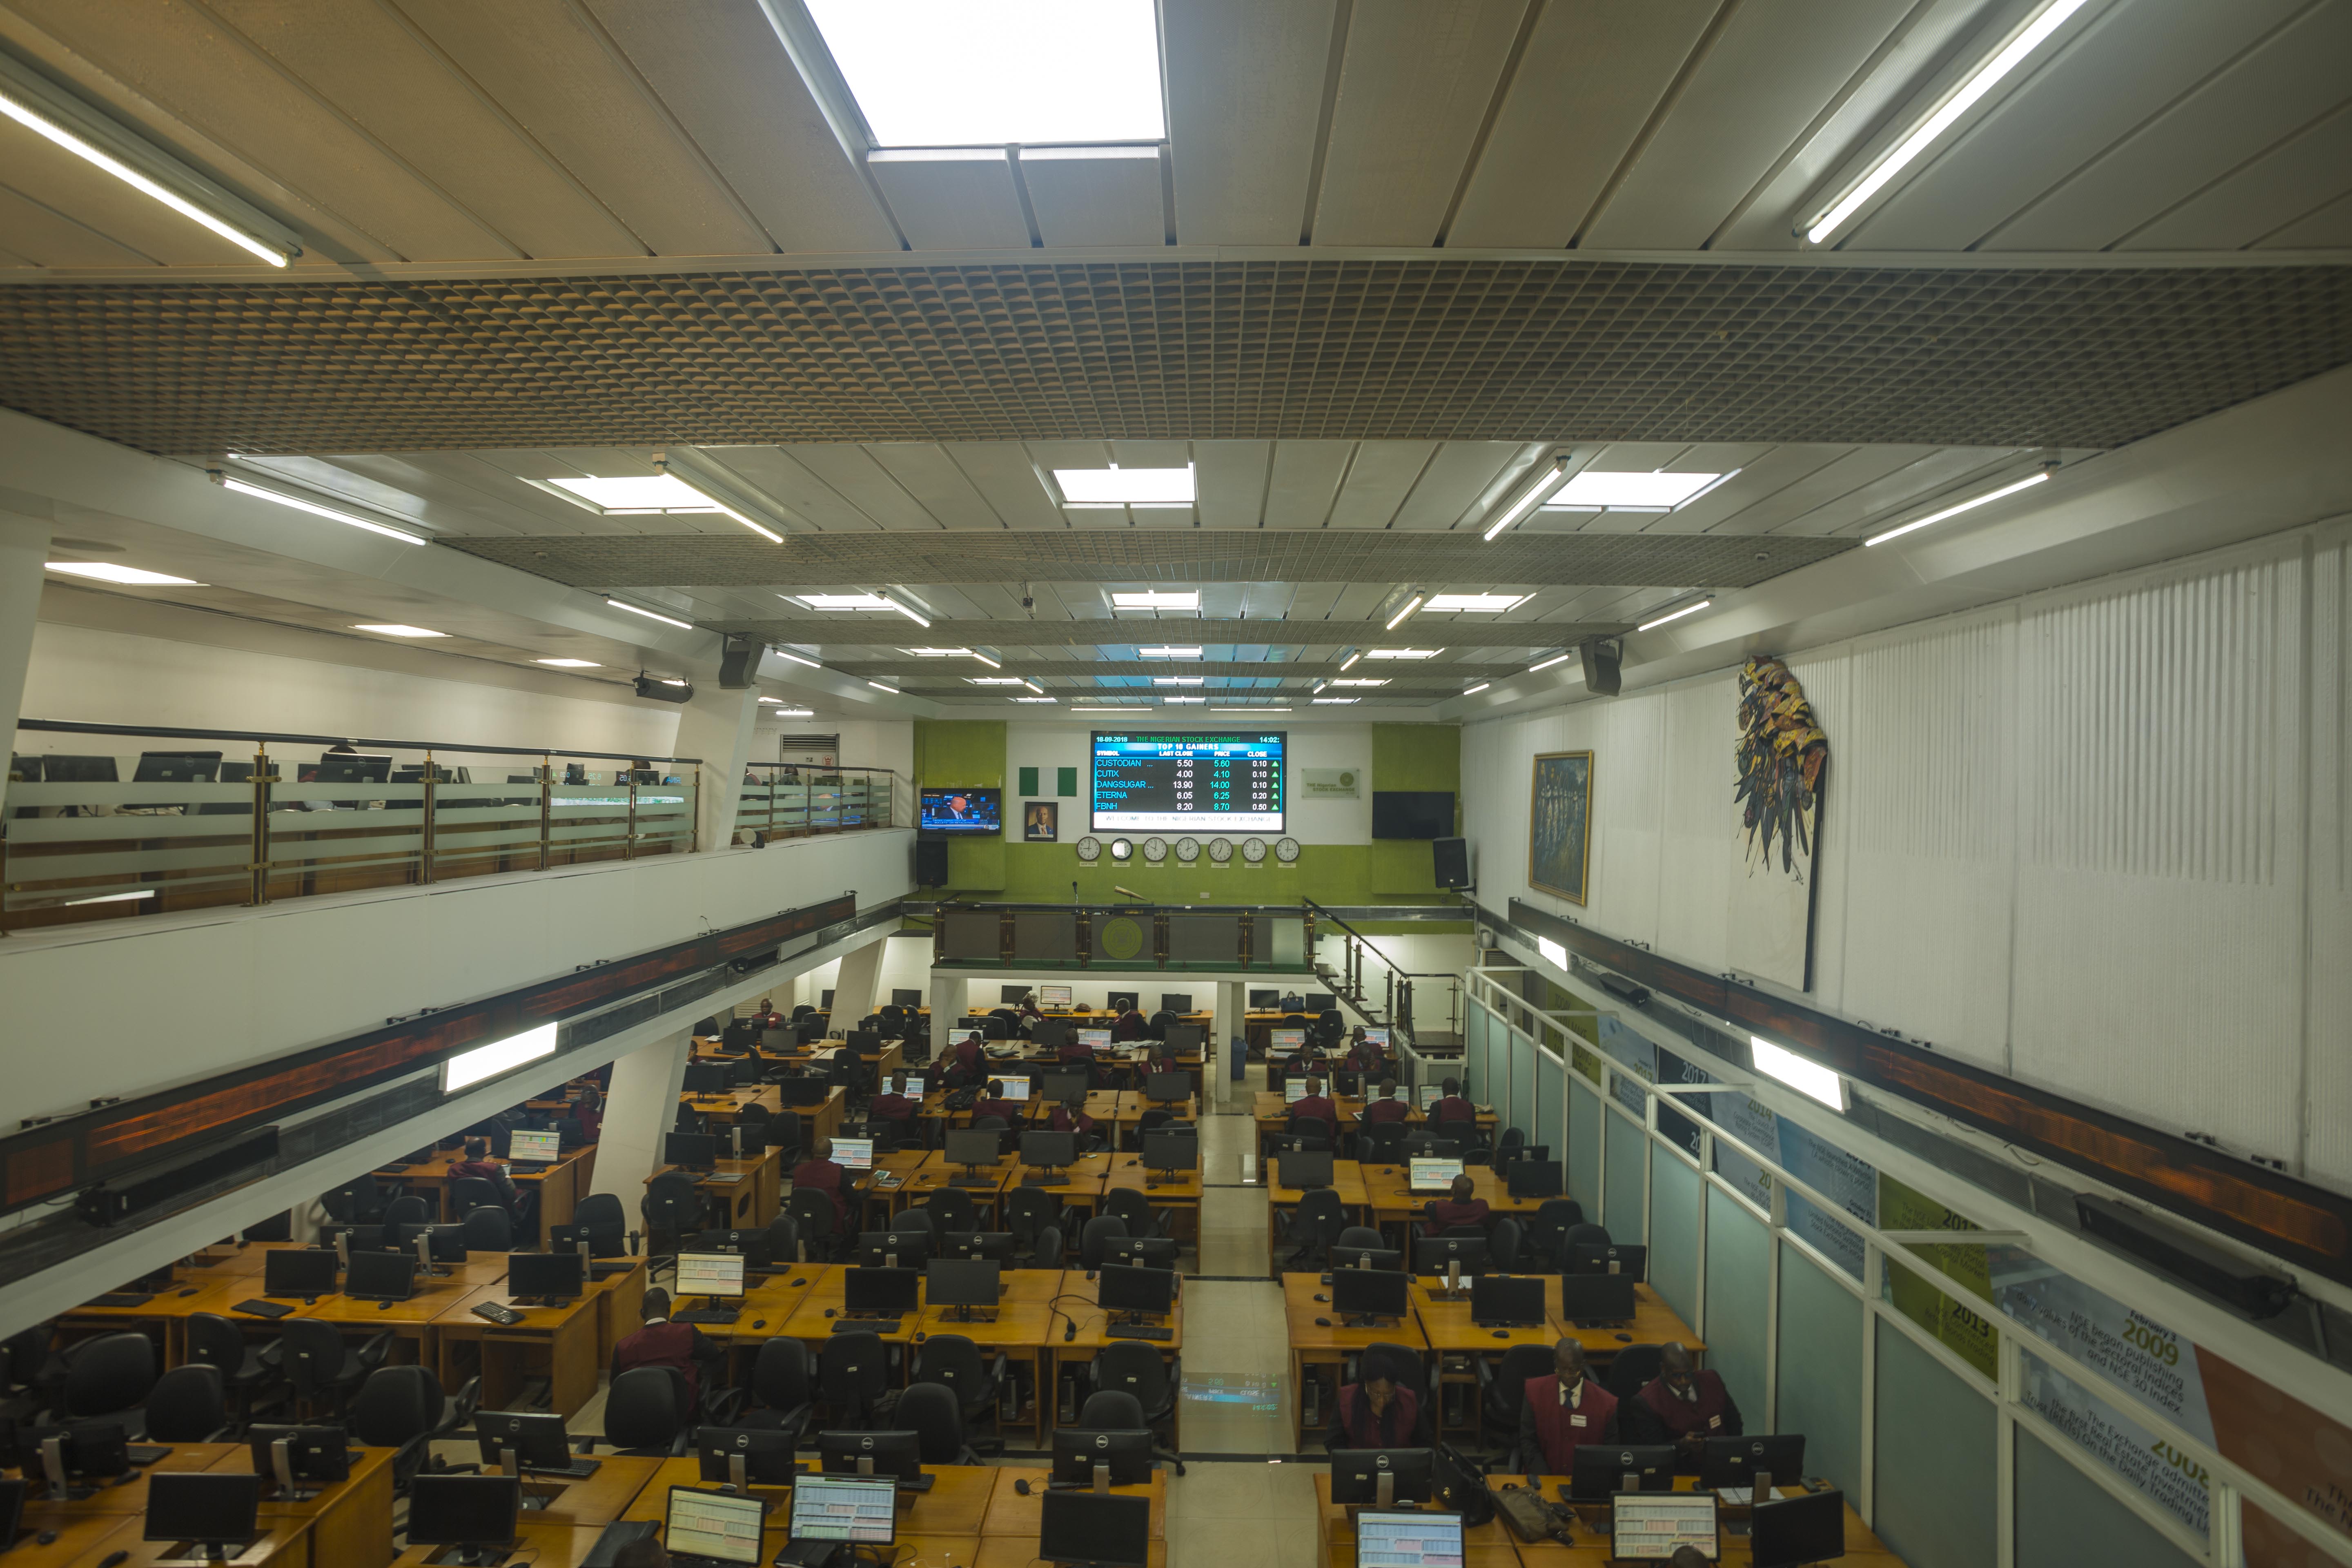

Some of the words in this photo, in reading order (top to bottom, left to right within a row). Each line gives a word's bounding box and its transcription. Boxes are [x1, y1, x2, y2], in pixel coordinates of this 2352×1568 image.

[1682, 1062, 1706, 1083] 2017
[1748, 1099, 1772, 1122] 2014
[1952, 1300, 1990, 1339] 2013
[2122, 1318, 2179, 1367] 2009
[2130, 1309, 2170, 1339] February
[2038, 1305, 2067, 1330] values
[2068, 1324, 2080, 1339] of
[2080, 1330, 2098, 1348] the
[2099, 1340, 2141, 1376] Sectoral
[2143, 1365, 2185, 1403] Indices
[2070, 1310, 2090, 1328] NSE
[2091, 1323, 2124, 1350] began
[2125, 1346, 2184, 1390] publishing
[2087, 1348, 2107, 1368] and
[2108, 1361, 2130, 1383] NSE
[2131, 1375, 2147, 1393] 30
[2052, 1397, 2068, 1414] the
[2069, 1409, 2089, 1432] first
[2090, 1424, 2112, 1450] Real
[2114, 1443, 2148, 1474] Estate
[2087, 1408, 2106, 1430] The
[2107, 1424, 2160, 1468] Exchange
[2161, 1466, 2209, 1506] admitte
[2082, 1434, 2096, 1452] On
[2099, 1444, 2116, 1465] the
[2118, 1460, 2147, 1488] Daily
[2149, 1479, 2194, 1526] Trading
[2307, 1484, 2335, 1517] The
